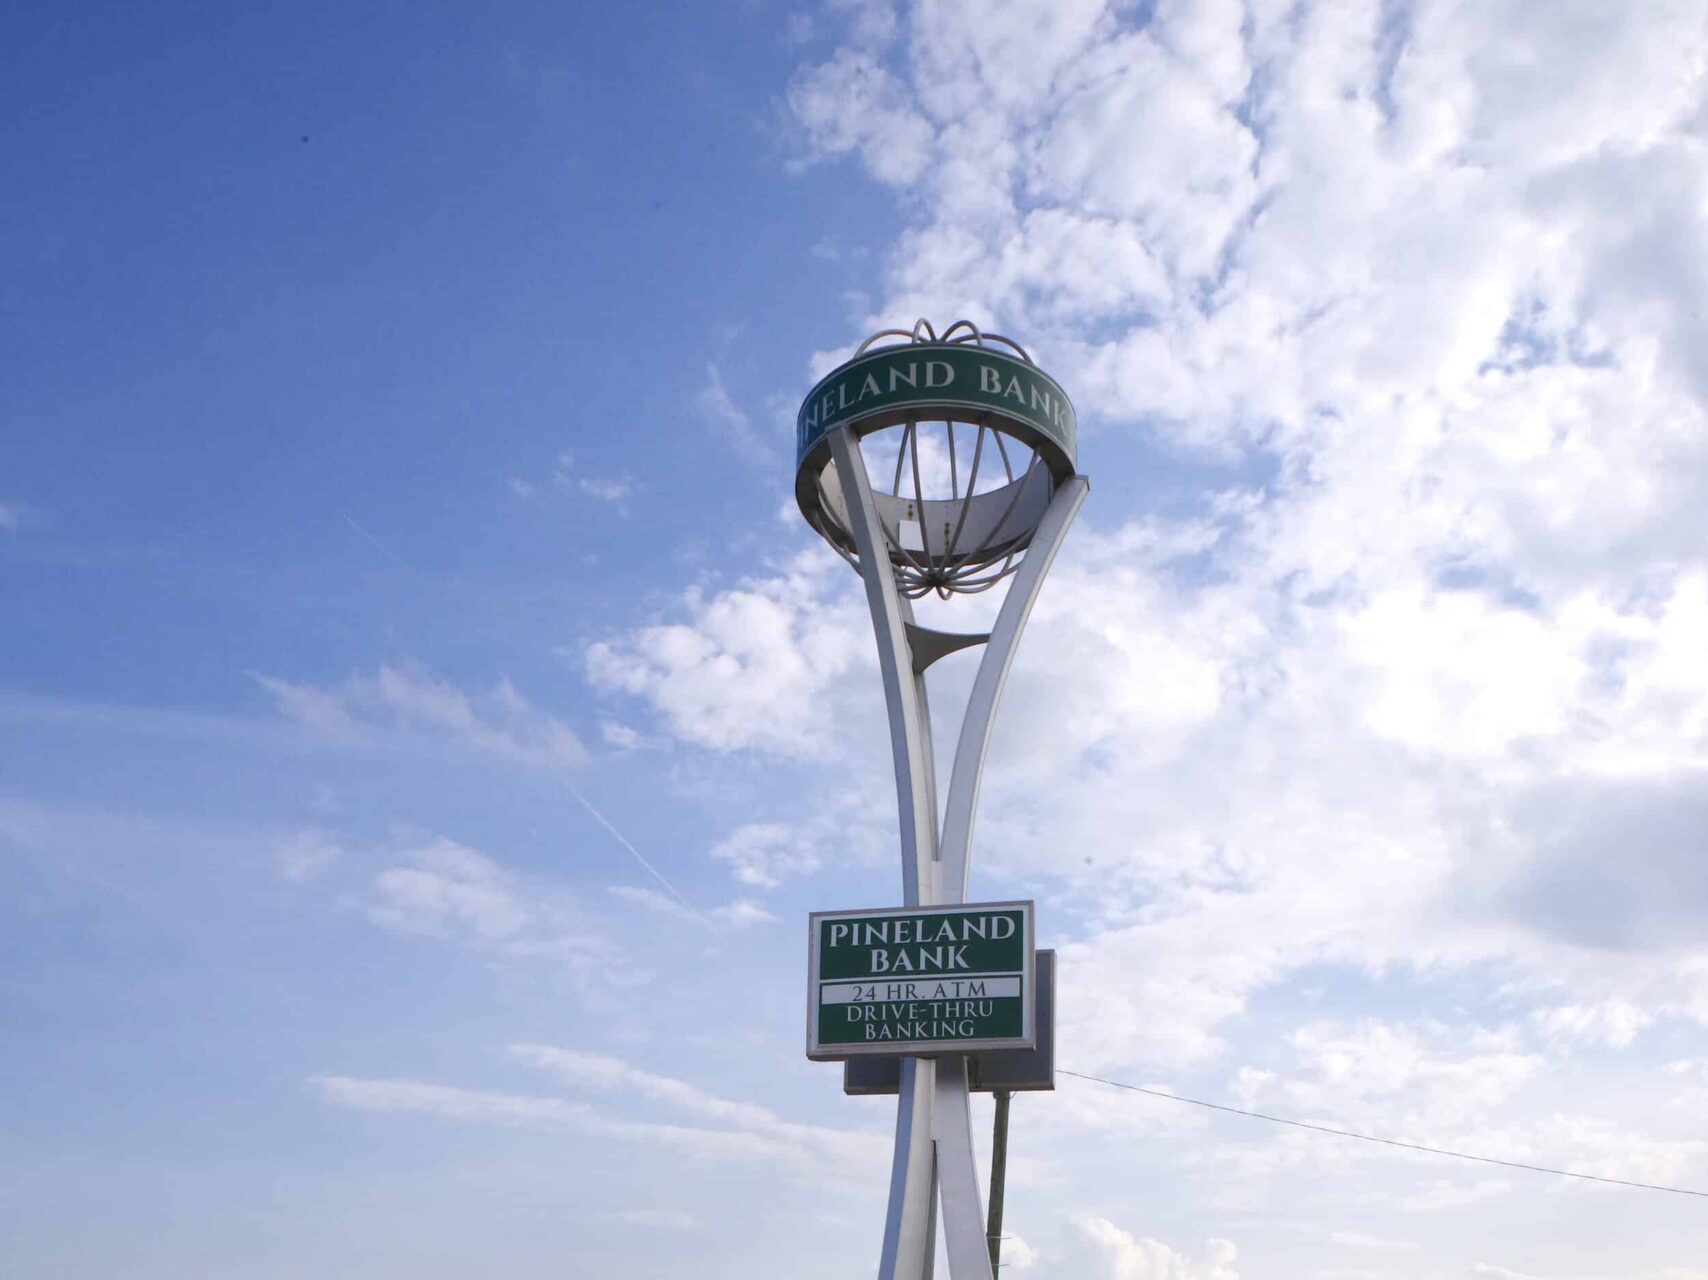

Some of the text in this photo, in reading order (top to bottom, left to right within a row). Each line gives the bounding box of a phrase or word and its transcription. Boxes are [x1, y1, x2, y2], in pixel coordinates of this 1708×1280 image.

[979, 365, 1068, 438] BANK
[828, 915, 1016, 948] PINELAND
[870, 945, 971, 973] BANK
[852, 981, 987, 1001] 24 HR. ATM
[847, 1000, 994, 1022] DRIVE-THRU
[864, 1019, 975, 1040] BANKING
